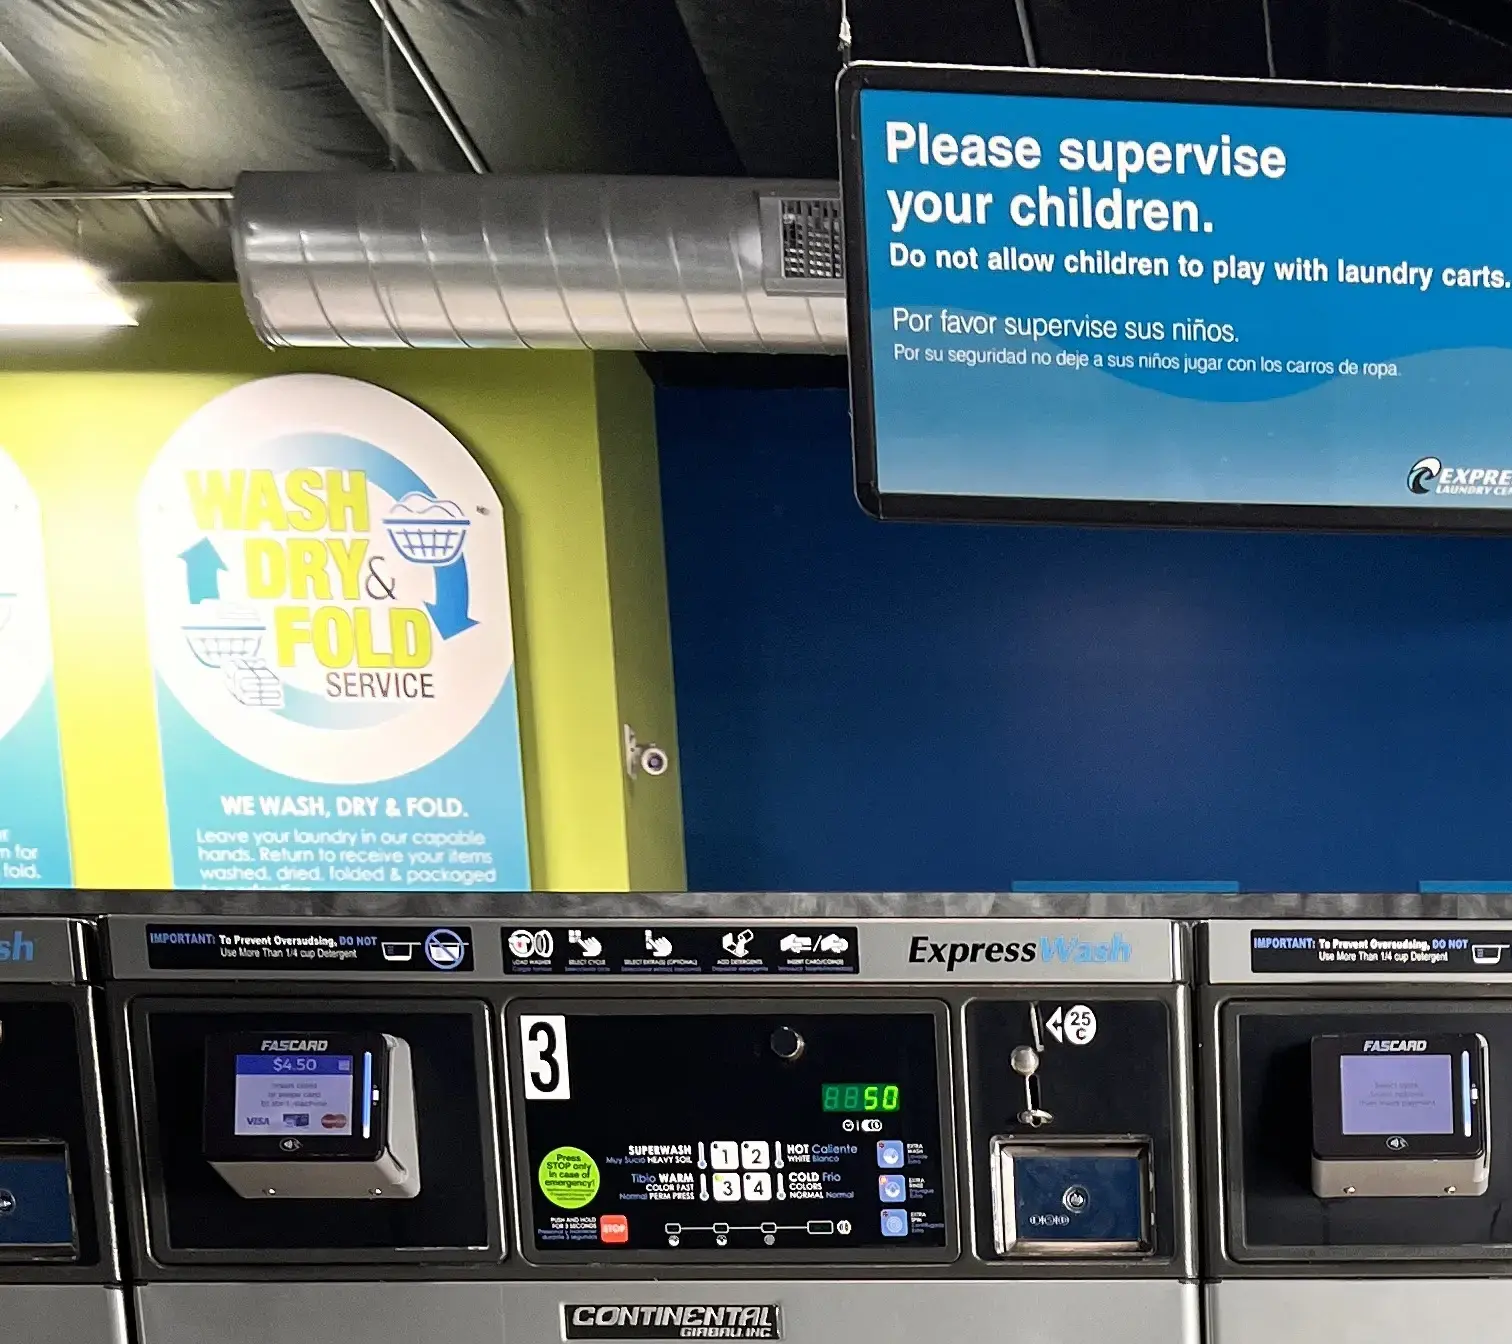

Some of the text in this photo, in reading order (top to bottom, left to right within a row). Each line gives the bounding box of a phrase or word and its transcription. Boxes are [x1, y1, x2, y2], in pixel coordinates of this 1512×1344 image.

[885, 121, 1287, 183] Please supervise
[886, 185, 1214, 232] your children.
[889, 242, 1511, 291] Do not allow children to play with laundry carts.
[892, 307, 1240, 343] Por favor supervise sus niños.
[894, 343, 1401, 379] Por su seguridad no deje a sus niños jugar con los carros de ropa.
[1436, 485, 1491, 496] LAUNDRY
[183, 468, 370, 532] WASH
[242, 538, 396, 600] DRY &
[273, 605, 433, 669] FOLD
[326, 672, 435, 699] SERVICE
[220, 795, 469, 818] WE WASH, DRY & FOLD.
[196, 828, 486, 848] Leave your laundry in our capable
[198, 846, 493, 868] hands. Return to receive your items
[329, 866, 385, 883] folded
[390, 867, 402, 883] &
[407, 867, 497, 885] packaged
[150, 933, 216, 945] IMPORTANT:
[219, 935, 231, 945] To
[234, 935, 272, 946] Prevent
[339, 936, 354, 946] DO
[356, 936, 378, 946] NOT
[220, 947, 357, 960] Use More Than 1/4 cup Detergent
[1070, 1012, 1091, 1026] 25
[1076, 1028, 1087, 1040] C
[261, 1040, 328, 1051] FASCARD
[1364, 1040, 1428, 1051] FASCARD
[528, 1021, 560, 1093] 3
[273, 1057, 317, 1072] $4.50
[247, 1117, 270, 1126] VISA
[628, 1145, 692, 1156] SUPERWASH
[787, 1144, 858, 1155] HOT Caliente
[557, 1154, 582, 1162] Press
[605, 1155, 693, 1165] Muy Sucio HEAVY SOIL
[722, 1149, 729, 1165] 1
[751, 1149, 763, 1165] 2
[787, 1155, 840, 1163] WHITE Blanco
[547, 1162, 592, 1175] STOP only
[549, 1170, 557, 1178] in
[582, 1169, 590, 1178] of
[631, 1173, 694, 1183] Tibio WARM
[789, 1172, 841, 1182] COLD Frio
[646, 1184, 694, 1192] COLOR FAST
[723, 1181, 733, 1196] 3
[753, 1181, 764, 1195] 4
[789, 1183, 822, 1191] COLORS
[619, 1192, 695, 1200] Normal PERM PRESS
[789, 1191, 824, 1199] NORMAL
[602, 1224, 627, 1234] STOP
[572, 1306, 773, 1327] CONTINENTAL
